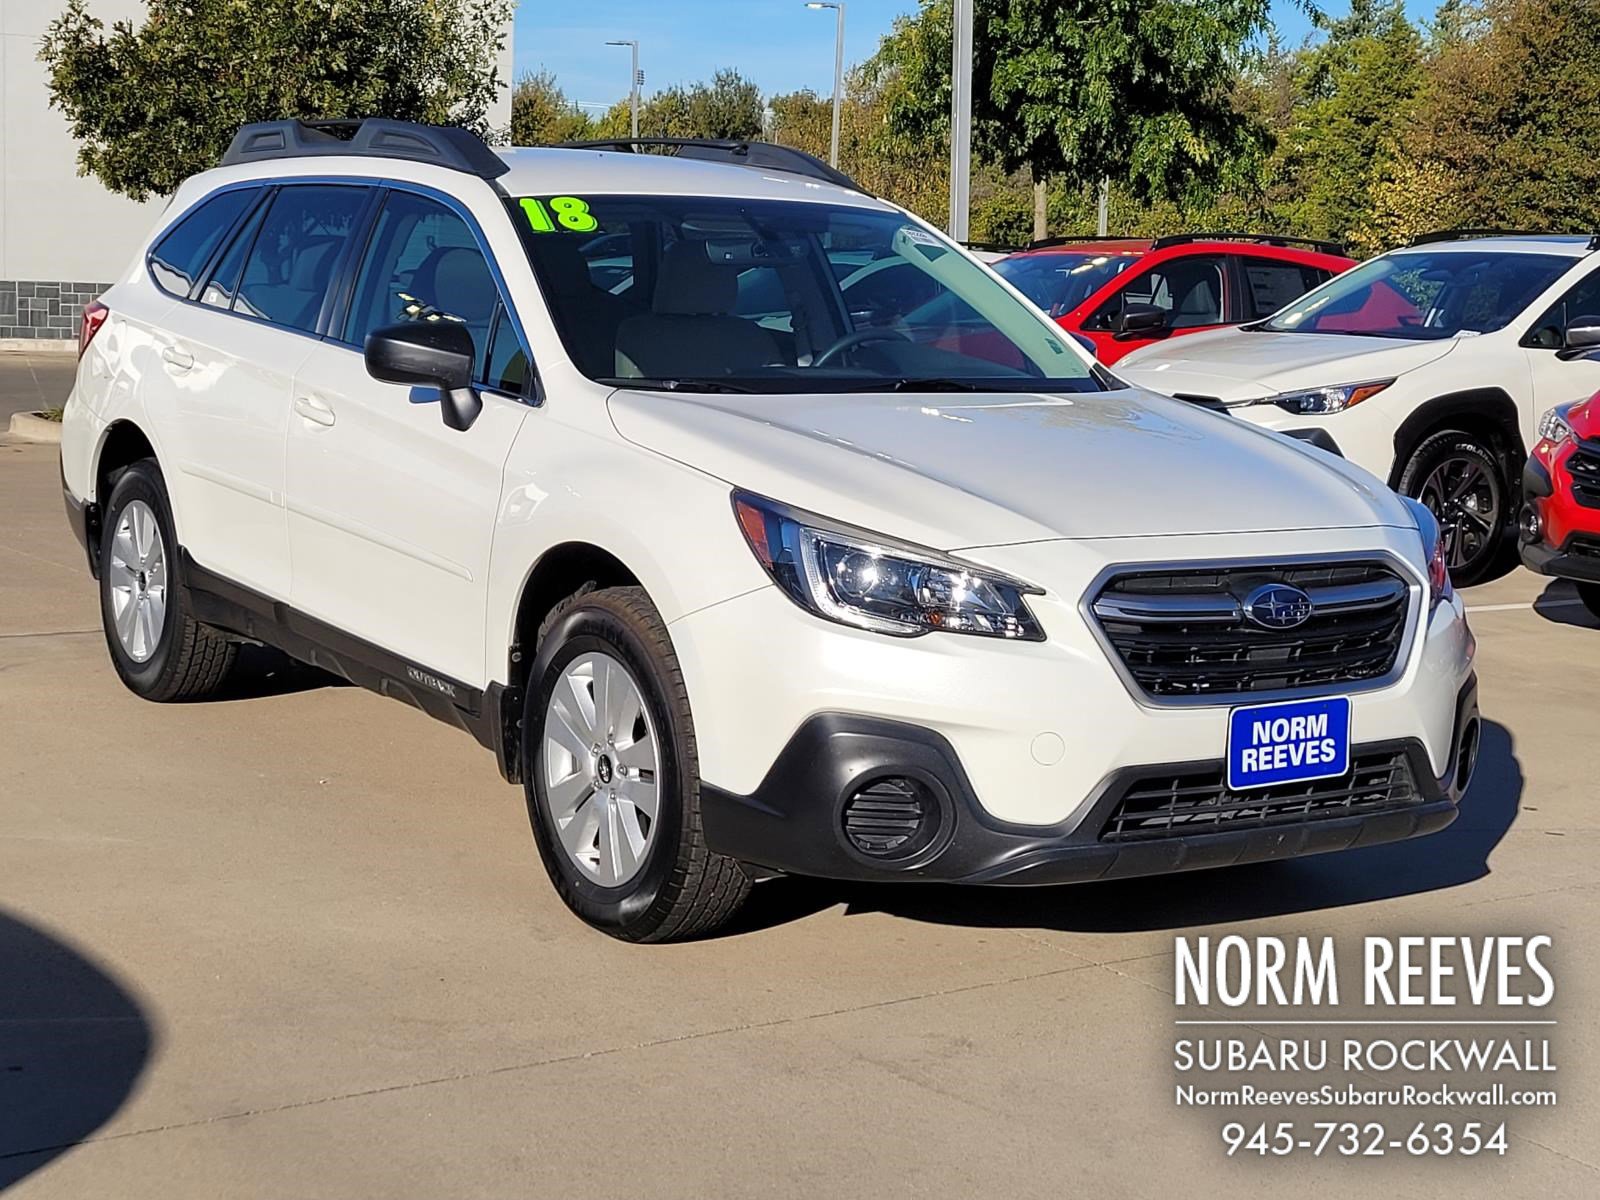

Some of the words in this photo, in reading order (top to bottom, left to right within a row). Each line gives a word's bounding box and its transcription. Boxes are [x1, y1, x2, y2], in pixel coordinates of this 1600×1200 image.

[519, 196, 599, 233] 18
[1252, 713, 1328, 745] NORM
[1241, 738, 1336, 773] REEVES
